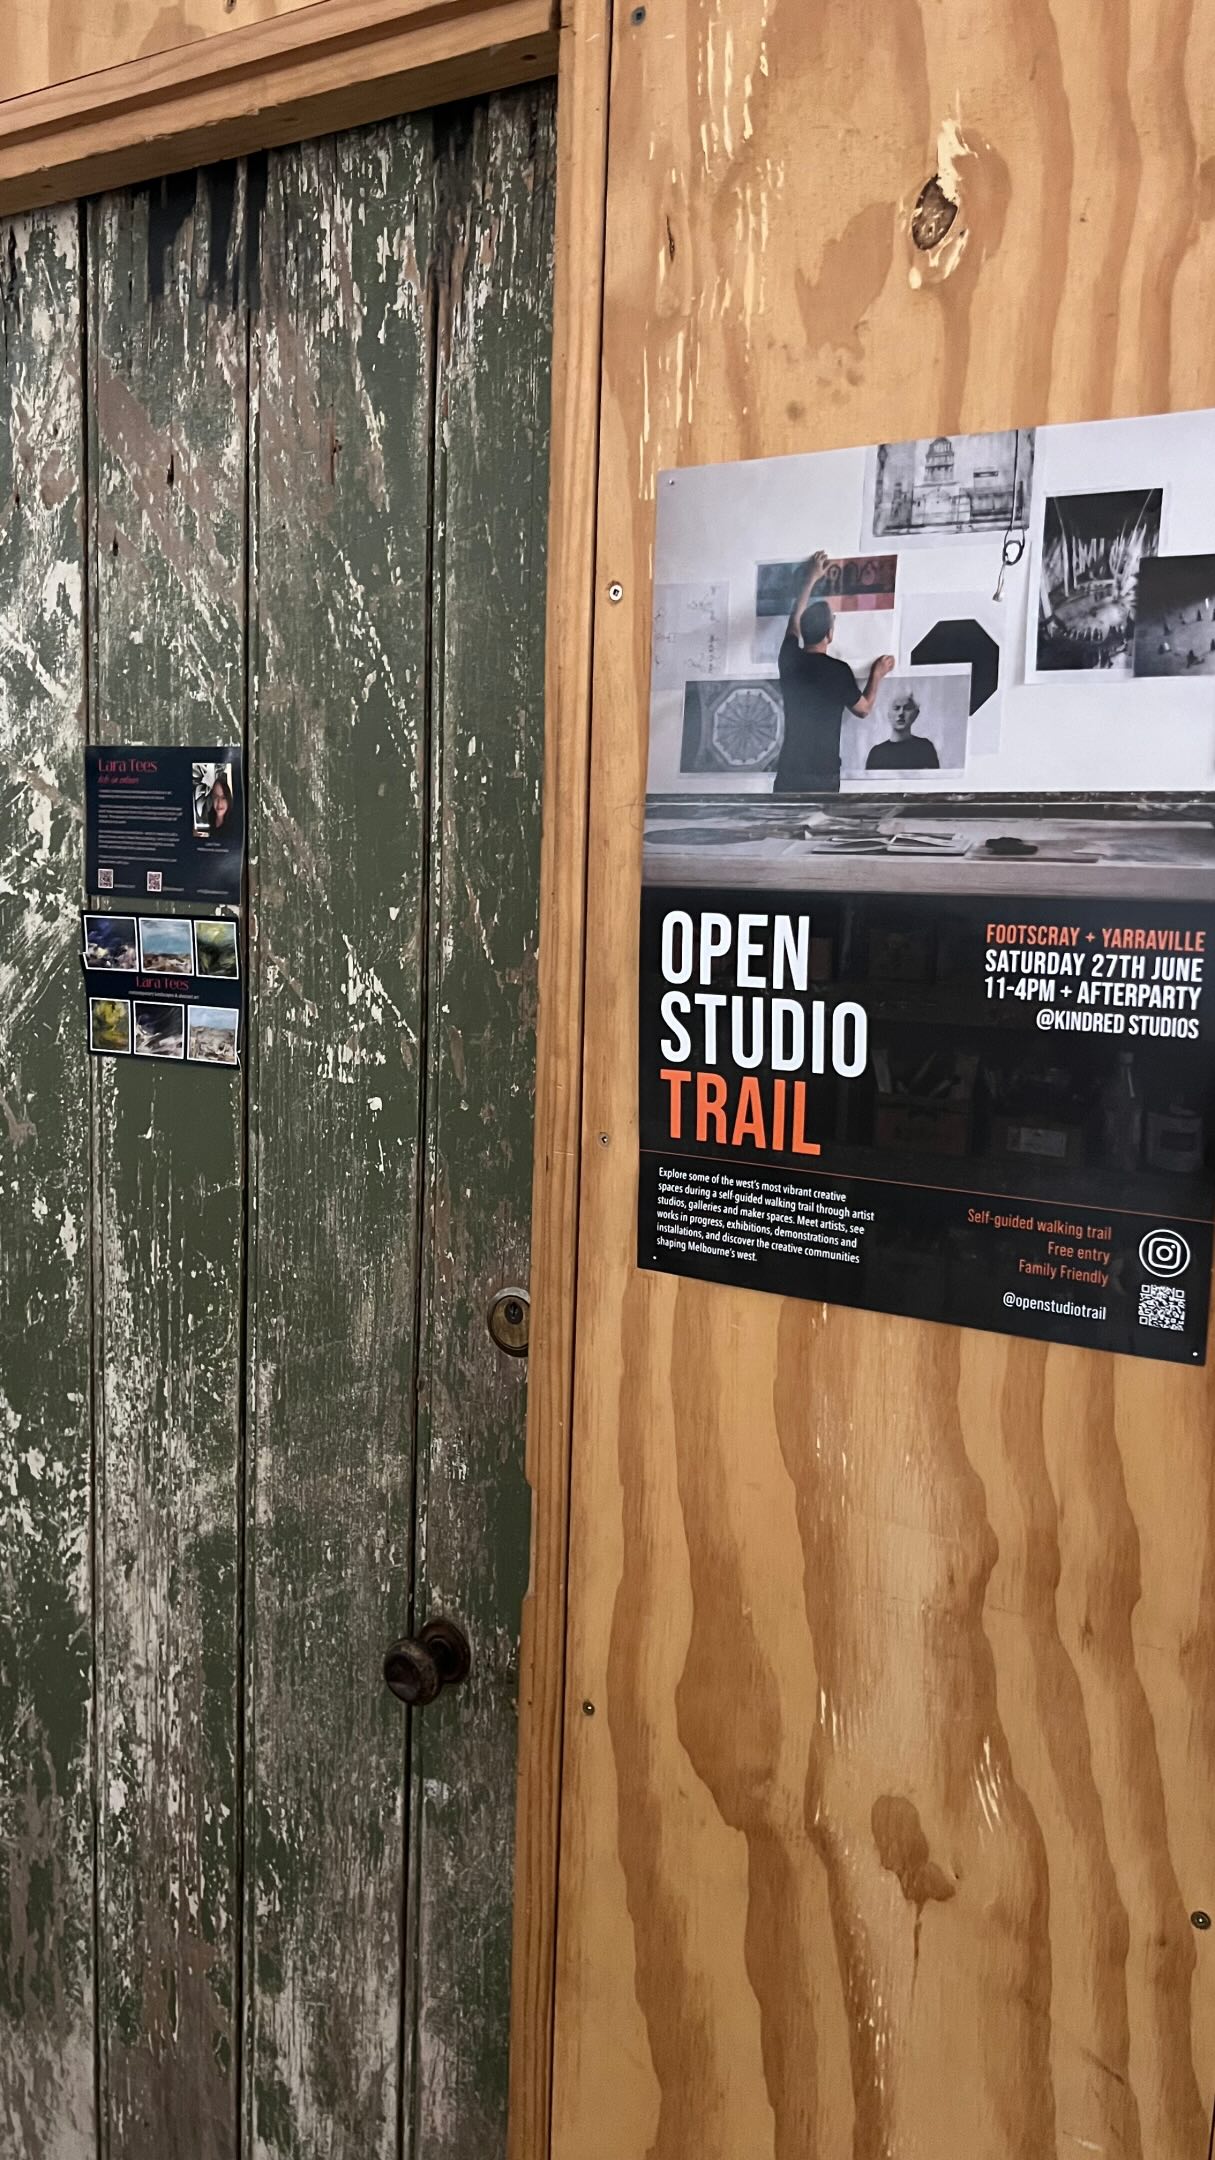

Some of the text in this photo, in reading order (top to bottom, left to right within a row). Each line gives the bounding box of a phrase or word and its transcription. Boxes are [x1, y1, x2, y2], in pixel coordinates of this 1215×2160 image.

[98, 759, 126, 773] Lara
[662, 911, 809, 991] OPEN
[987, 924, 1206, 952] FOOTSCRAY + YARRAVILLE
[985, 949, 1204, 982] SATURDAY 27TH JUNE
[985, 976, 1202, 1010] 11-4PM + AFTERPARTY
[661, 991, 867, 1077] STUDIO
[1037, 1009, 1199, 1039] @KINDRED STUDIOS
[660, 1069, 820, 1155] TRAIL
[659, 1167, 846, 1202] Explore some of the west's most vibrant creative
[658, 1183, 683, 1193] spaces
[685, 1185, 710, 1199] during
[719, 1190, 763, 1204] self-guided
[765, 1197, 796, 1212] walking
[798, 1202, 814, 1212] trail
[816, 1203, 850, 1219] through
[852, 1210, 874, 1221] artist
[658, 1196, 864, 1234] studios, galleries and maker spaces. Meet artists, see
[657, 1210, 857, 1248] works in progress, exhibitions, demonstrations and
[968, 1209, 1111, 1239] Self-guided walking trail
[657, 1222, 859, 1263] installations, and discover the creative communities
[657, 1236, 757, 1261] shaping Melbourne's west.
[1048, 1242, 1110, 1264] Free entry
[1019, 1259, 1108, 1287] Family Friendly
[1003, 1292, 1106, 1319] @openstudiotrail
